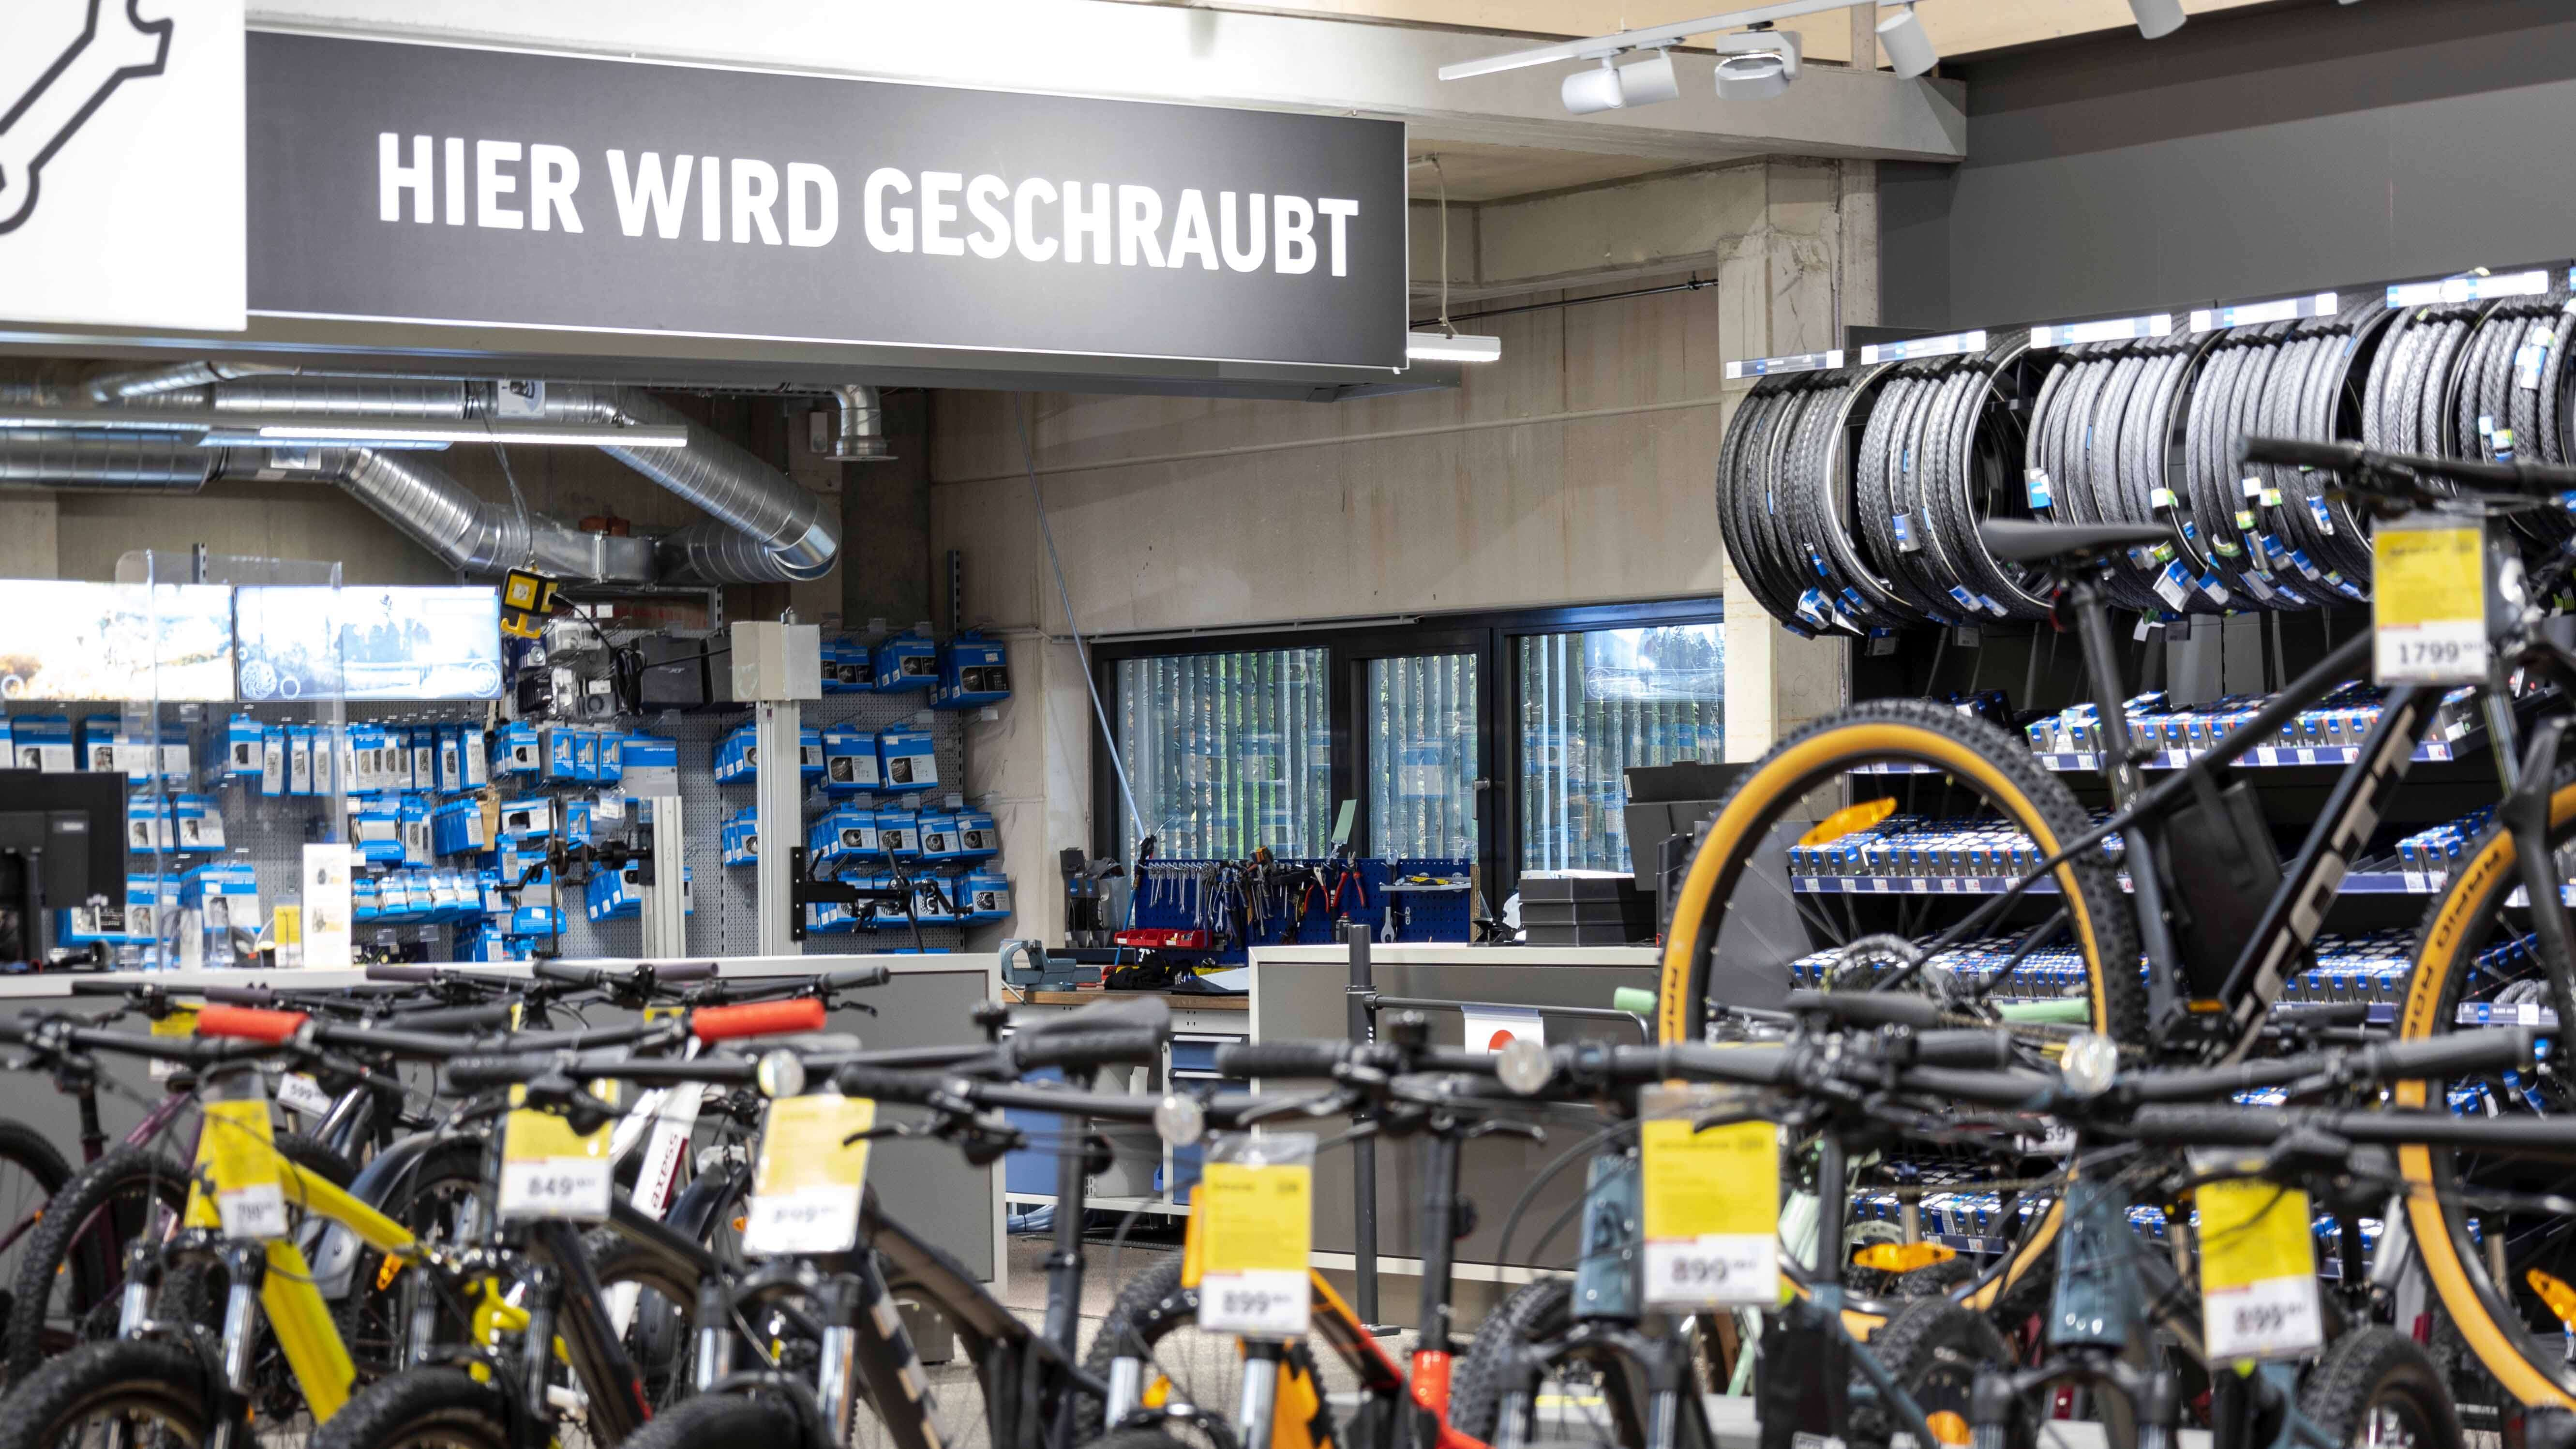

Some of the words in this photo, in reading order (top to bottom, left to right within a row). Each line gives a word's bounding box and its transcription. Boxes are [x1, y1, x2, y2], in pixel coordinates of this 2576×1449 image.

[380, 133, 584, 233] HIER
[606, 149, 839, 247] WIRD
[864, 167, 1358, 277] GESCHRAUBT
[2398, 641, 2459, 664] 1799
